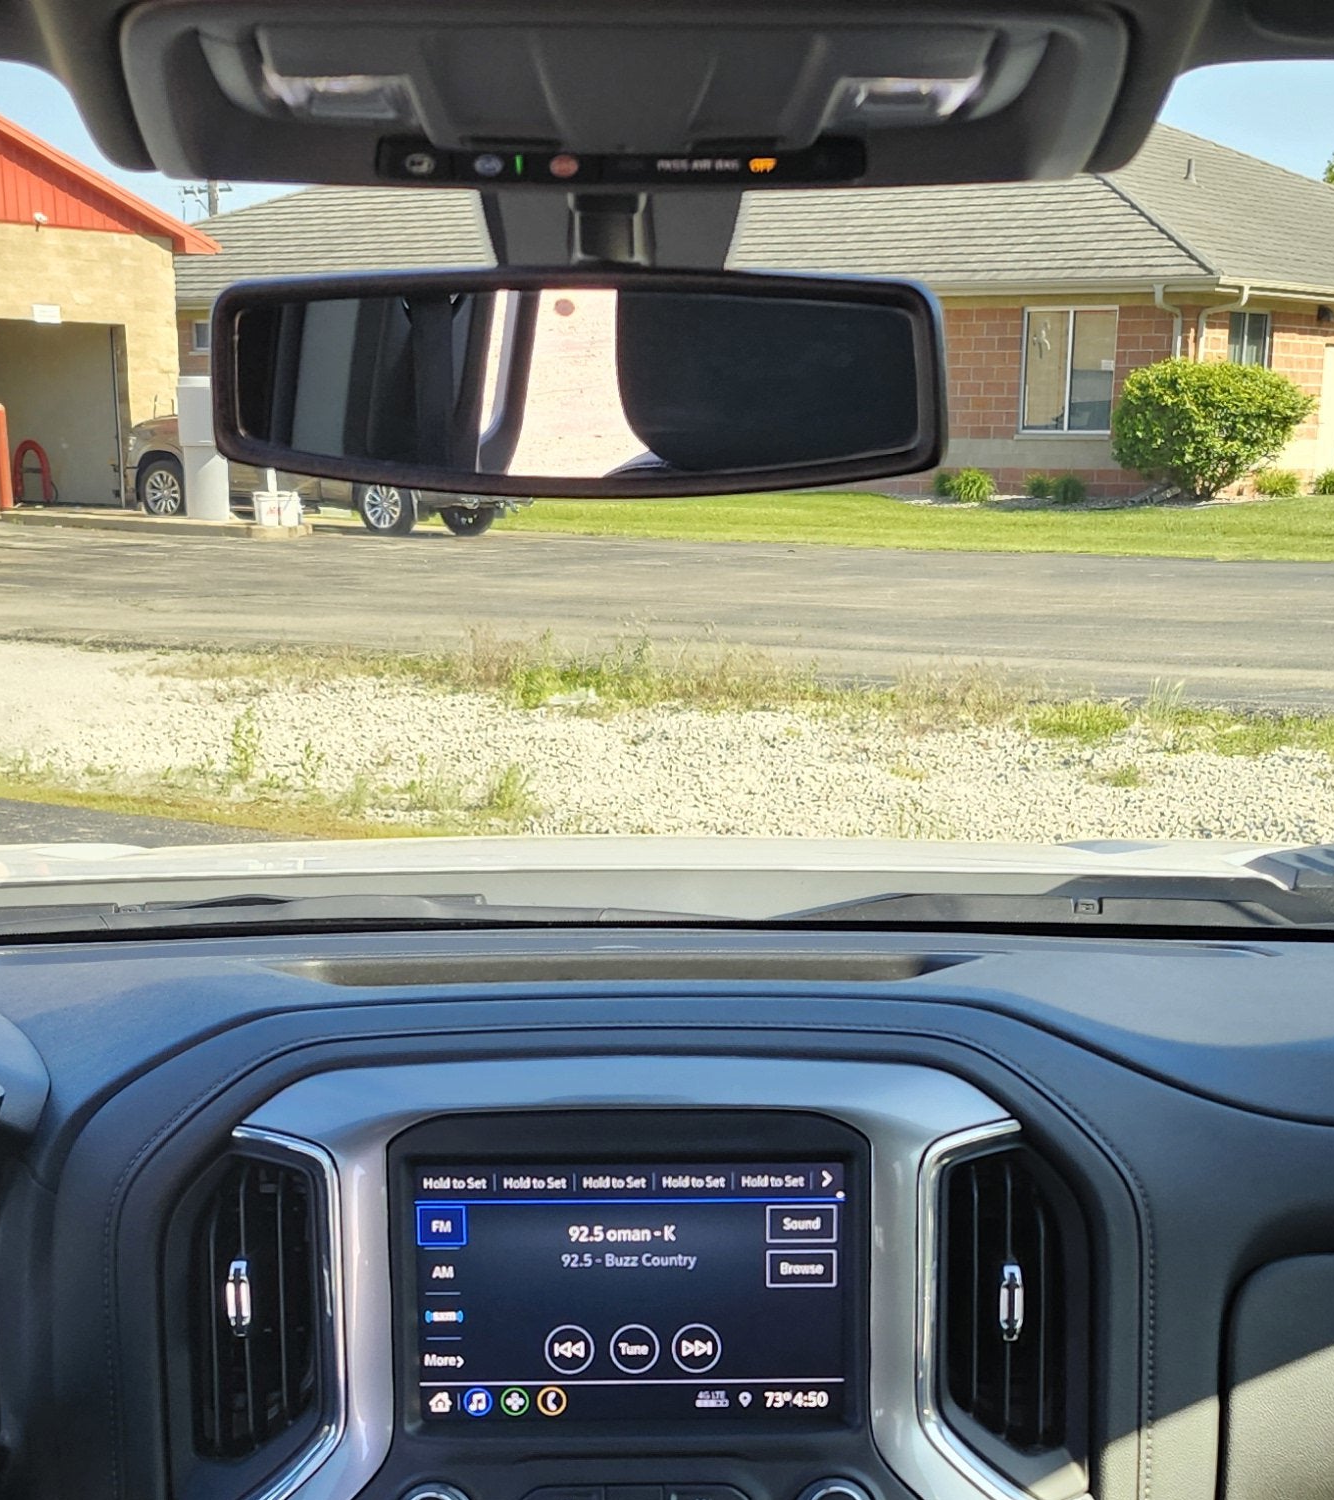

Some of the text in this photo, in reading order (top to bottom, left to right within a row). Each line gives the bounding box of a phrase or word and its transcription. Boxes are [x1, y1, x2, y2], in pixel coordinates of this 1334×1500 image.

[423, 1177, 487, 1189] Hold to Set
[503, 1177, 567, 1189] Hold to Set
[582, 1177, 646, 1189] Hold to Set
[662, 1176, 726, 1188] Hold to Set
[741, 1175, 805, 1187] Hold to Set
[431, 1220, 452, 1233] FM
[782, 1217, 821, 1231] Sound
[568, 1225, 604, 1242] 92.5
[606, 1229, 651, 1242] oman
[664, 1225, 676, 1242] K
[561, 1254, 592, 1267] 92.5
[605, 1254, 638, 1267] Buzz
[642, 1253, 697, 1269] Country
[432, 1266, 454, 1279] AM
[780, 1262, 824, 1276] Browse
[618, 1343, 649, 1356] Tune
[424, 1354, 457, 1367] More
[793, 1391, 829, 1408] 4:50
